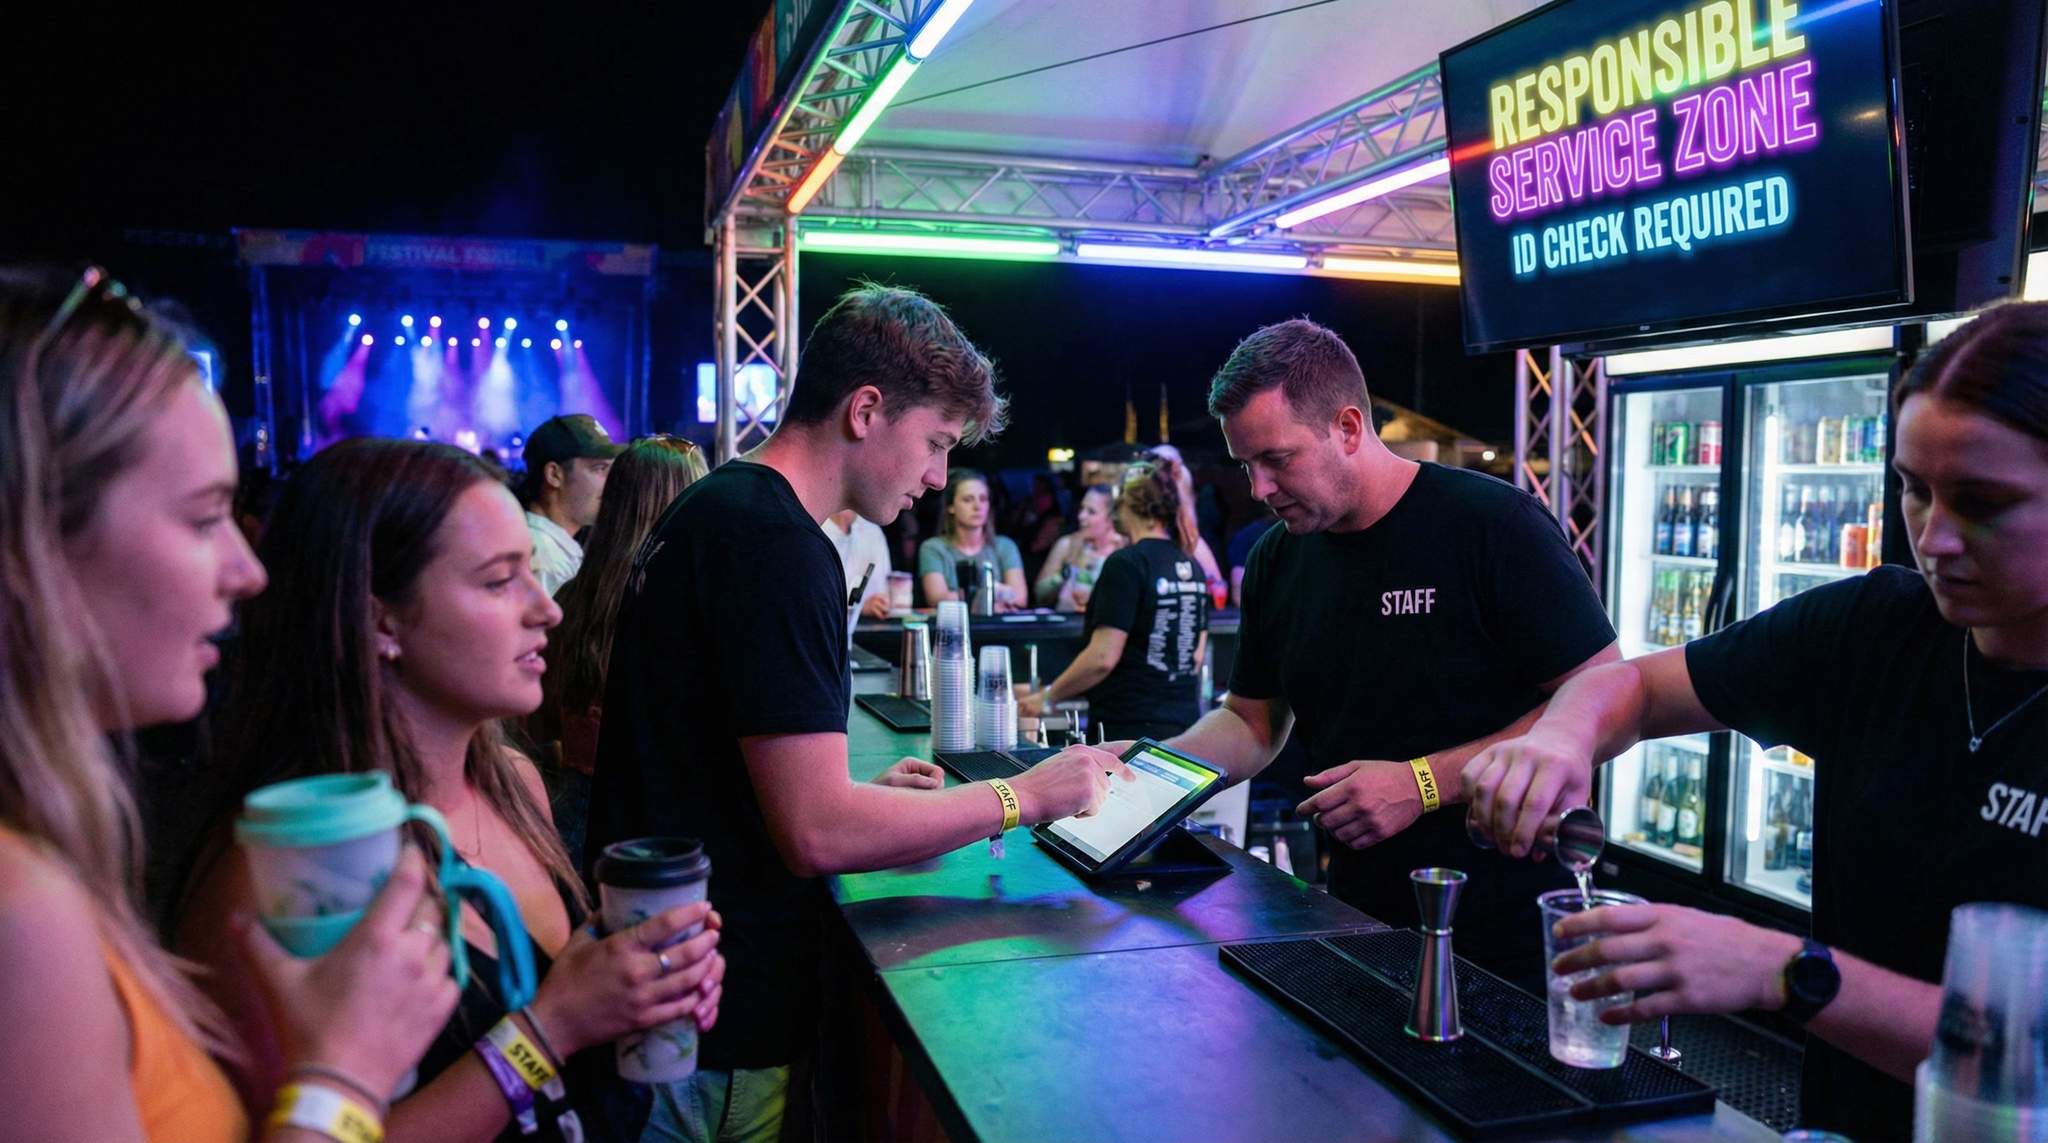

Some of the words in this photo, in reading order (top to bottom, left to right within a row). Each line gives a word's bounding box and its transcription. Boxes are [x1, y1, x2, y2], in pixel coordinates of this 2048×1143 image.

[1491, 0, 1806, 149] RESPONSIBLE
[1489, 109, 1662, 217] SERVICE
[1673, 60, 1817, 172] ZONE
[1513, 233, 1537, 274] ID
[1543, 211, 1628, 269] CHECK
[1634, 176, 1789, 251] REQUIRED
[1381, 588, 1436, 616] STAFF
[995, 782, 1017, 811] STAFF
[1418, 770, 1436, 800] STAFF
[508, 1043, 551, 1082] STAFF
